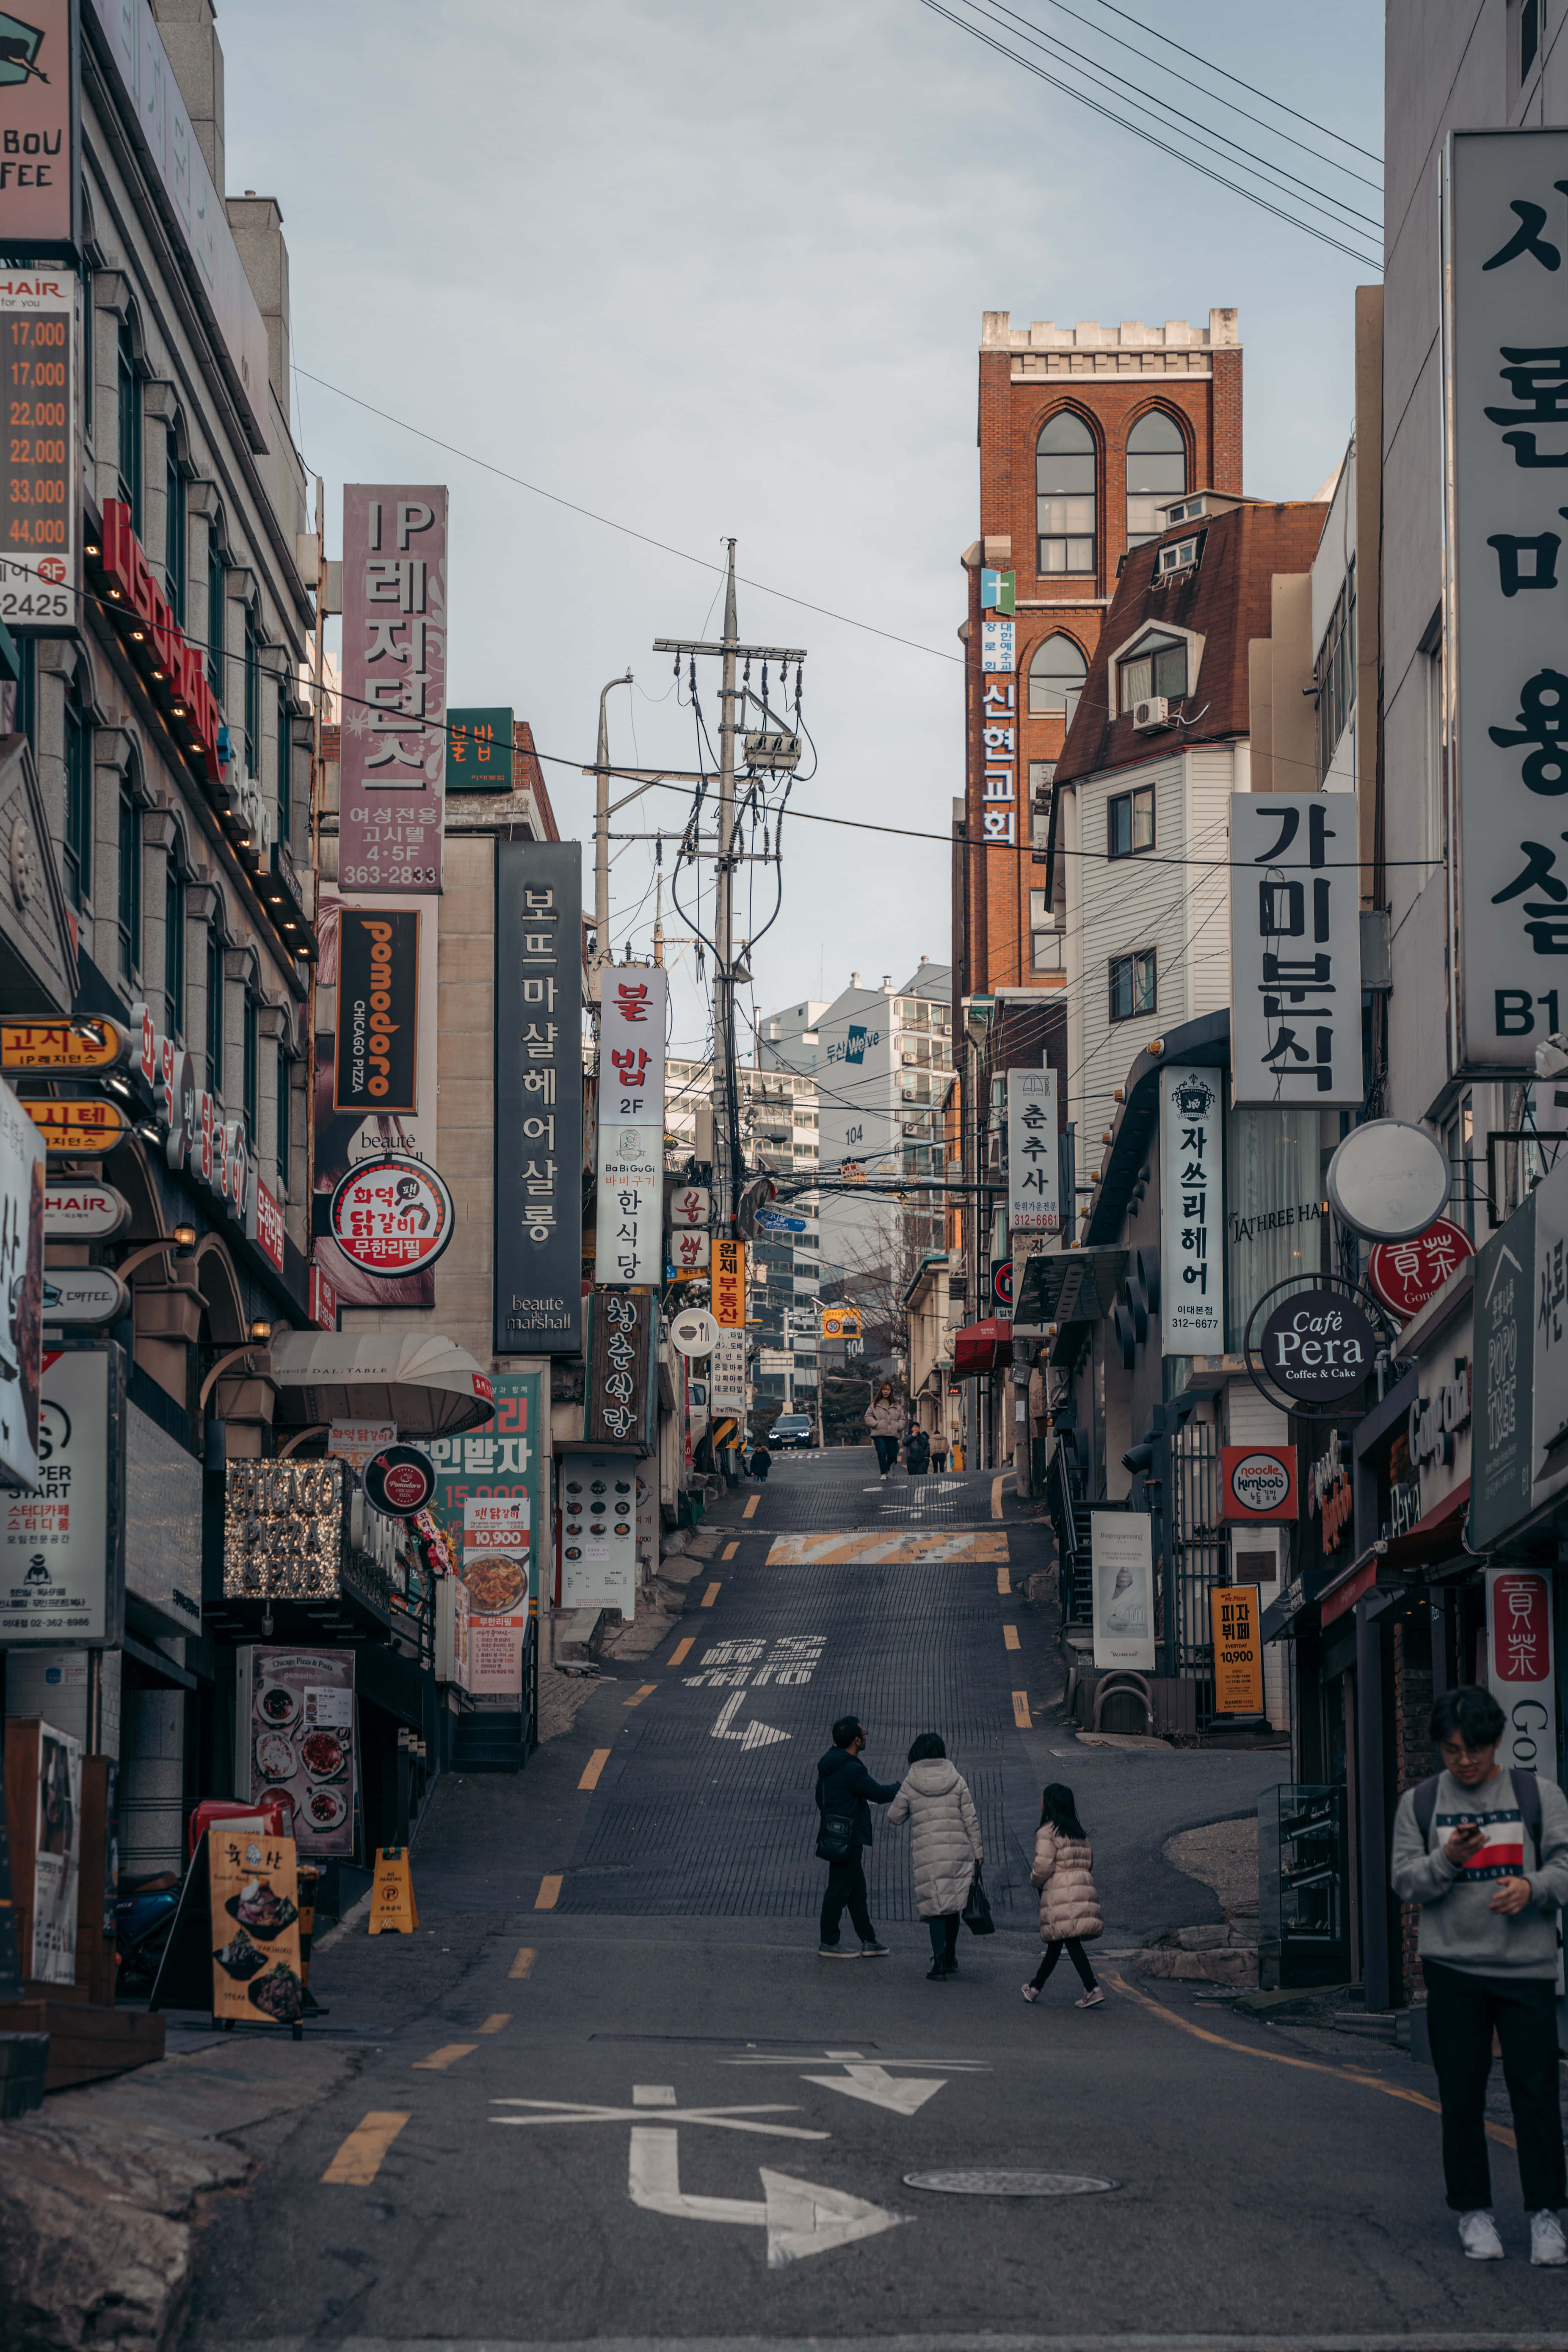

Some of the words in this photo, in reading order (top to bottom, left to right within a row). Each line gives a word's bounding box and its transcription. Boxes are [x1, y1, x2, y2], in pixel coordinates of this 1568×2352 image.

[1, 298, 15, 307] for
[10, 322, 65, 348] 17,000
[10, 362, 65, 388] 17,000
[10, 402, 65, 429] 22,000
[10, 439, 65, 465] 22,000
[10, 479, 65, 506] 33,000
[10, 519, 65, 545] 44,000
[40, 563, 65, 580] 3F
[984, 622, 996, 671] 장로회
[1000, 622, 1013, 671] 대한예수교
[449, 724, 494, 762] 불밥
[983, 684, 1015, 845] 신현교회
[350, 808, 437, 824] 여성전용
[362, 827, 425, 843] 고시텔
[344, 866, 436, 884] 363-2833
[1255, 804, 1336, 1092] 가미분식
[360, 921, 400, 1096] pomodoro
[1495, 990, 1559, 1036] B1
[353, 1000, 365, 1055] CHICAGO
[5, 1024, 106, 1053] 고시
[352, 1058, 364, 1094] PIZZA
[620, 1099, 644, 1114] 2F
[24, 1107, 105, 1136] 시텔
[46, 1138, 96, 1147] 지던스
[361, 1132, 414, 1148] beauté
[846, 1124, 862, 1145] 104
[1021, 1105, 1049, 1195] 춘추사
[606, 1174, 655, 1187] 바비구기
[353, 1187, 394, 1205] 화덕
[401, 1183, 418, 1199] 팬
[1013, 1201, 1057, 1212] 학위가운전문
[1180, 1127, 1207, 1294] 자쓰리헤어
[350, 1210, 416, 1236] 닭갈비
[1014, 1214, 1058, 1227] 312-6661
[617, 1191, 642, 1279] 한식당
[352, 1239, 421, 1259] 무한리필
[512, 1295, 564, 1312] beauté
[1177, 1305, 1214, 1316] 이대본점
[506, 1313, 571, 1330] marshall
[531, 1310, 543, 1319] de
[1172, 1318, 1218, 1330] 312-6677
[846, 1338, 864, 1357] 104
[1274, 1332, 1365, 1366] Pera
[603, 1297, 637, 1438] 청춘식당
[1286, 1369, 1317, 1379] Coffee
[1320, 1370, 1328, 1379] &
[1331, 1368, 1356, 1378] Cake
[512, 1386, 527, 1394] 함께
[715, 1385, 742, 1394] 데코타일
[332, 1428, 355, 1441] 화덕
[38, 1466, 71, 1481] PER
[1241, 1465, 1283, 1477] noodle
[229, 1468, 334, 1512] CHICAGO
[389, 1481, 421, 1489] Pomodoro
[1238, 1476, 1284, 1491] kimbob
[1251, 1492, 1261, 1504] 누들
[1263, 1490, 1277, 1501] 김밥
[7, 1504, 69, 1518] 스터디카페
[475, 1507, 488, 1520] 팬
[490, 1507, 519, 1520] 닭갈비
[242, 1522, 321, 1550] PIZZA
[474, 1531, 521, 1547] 10,900
[1101, 1532, 1143, 1541] Bioprogramming
[266, 1560, 320, 1587] PUB
[479, 1617, 512, 1626] 무한리필
[1221, 1604, 1250, 1622] 피자
[1222, 1622, 1250, 1640] 뷔페
[1501, 1581, 1539, 1677] 貢茶
[1220, 1650, 1253, 1664] 10,900
